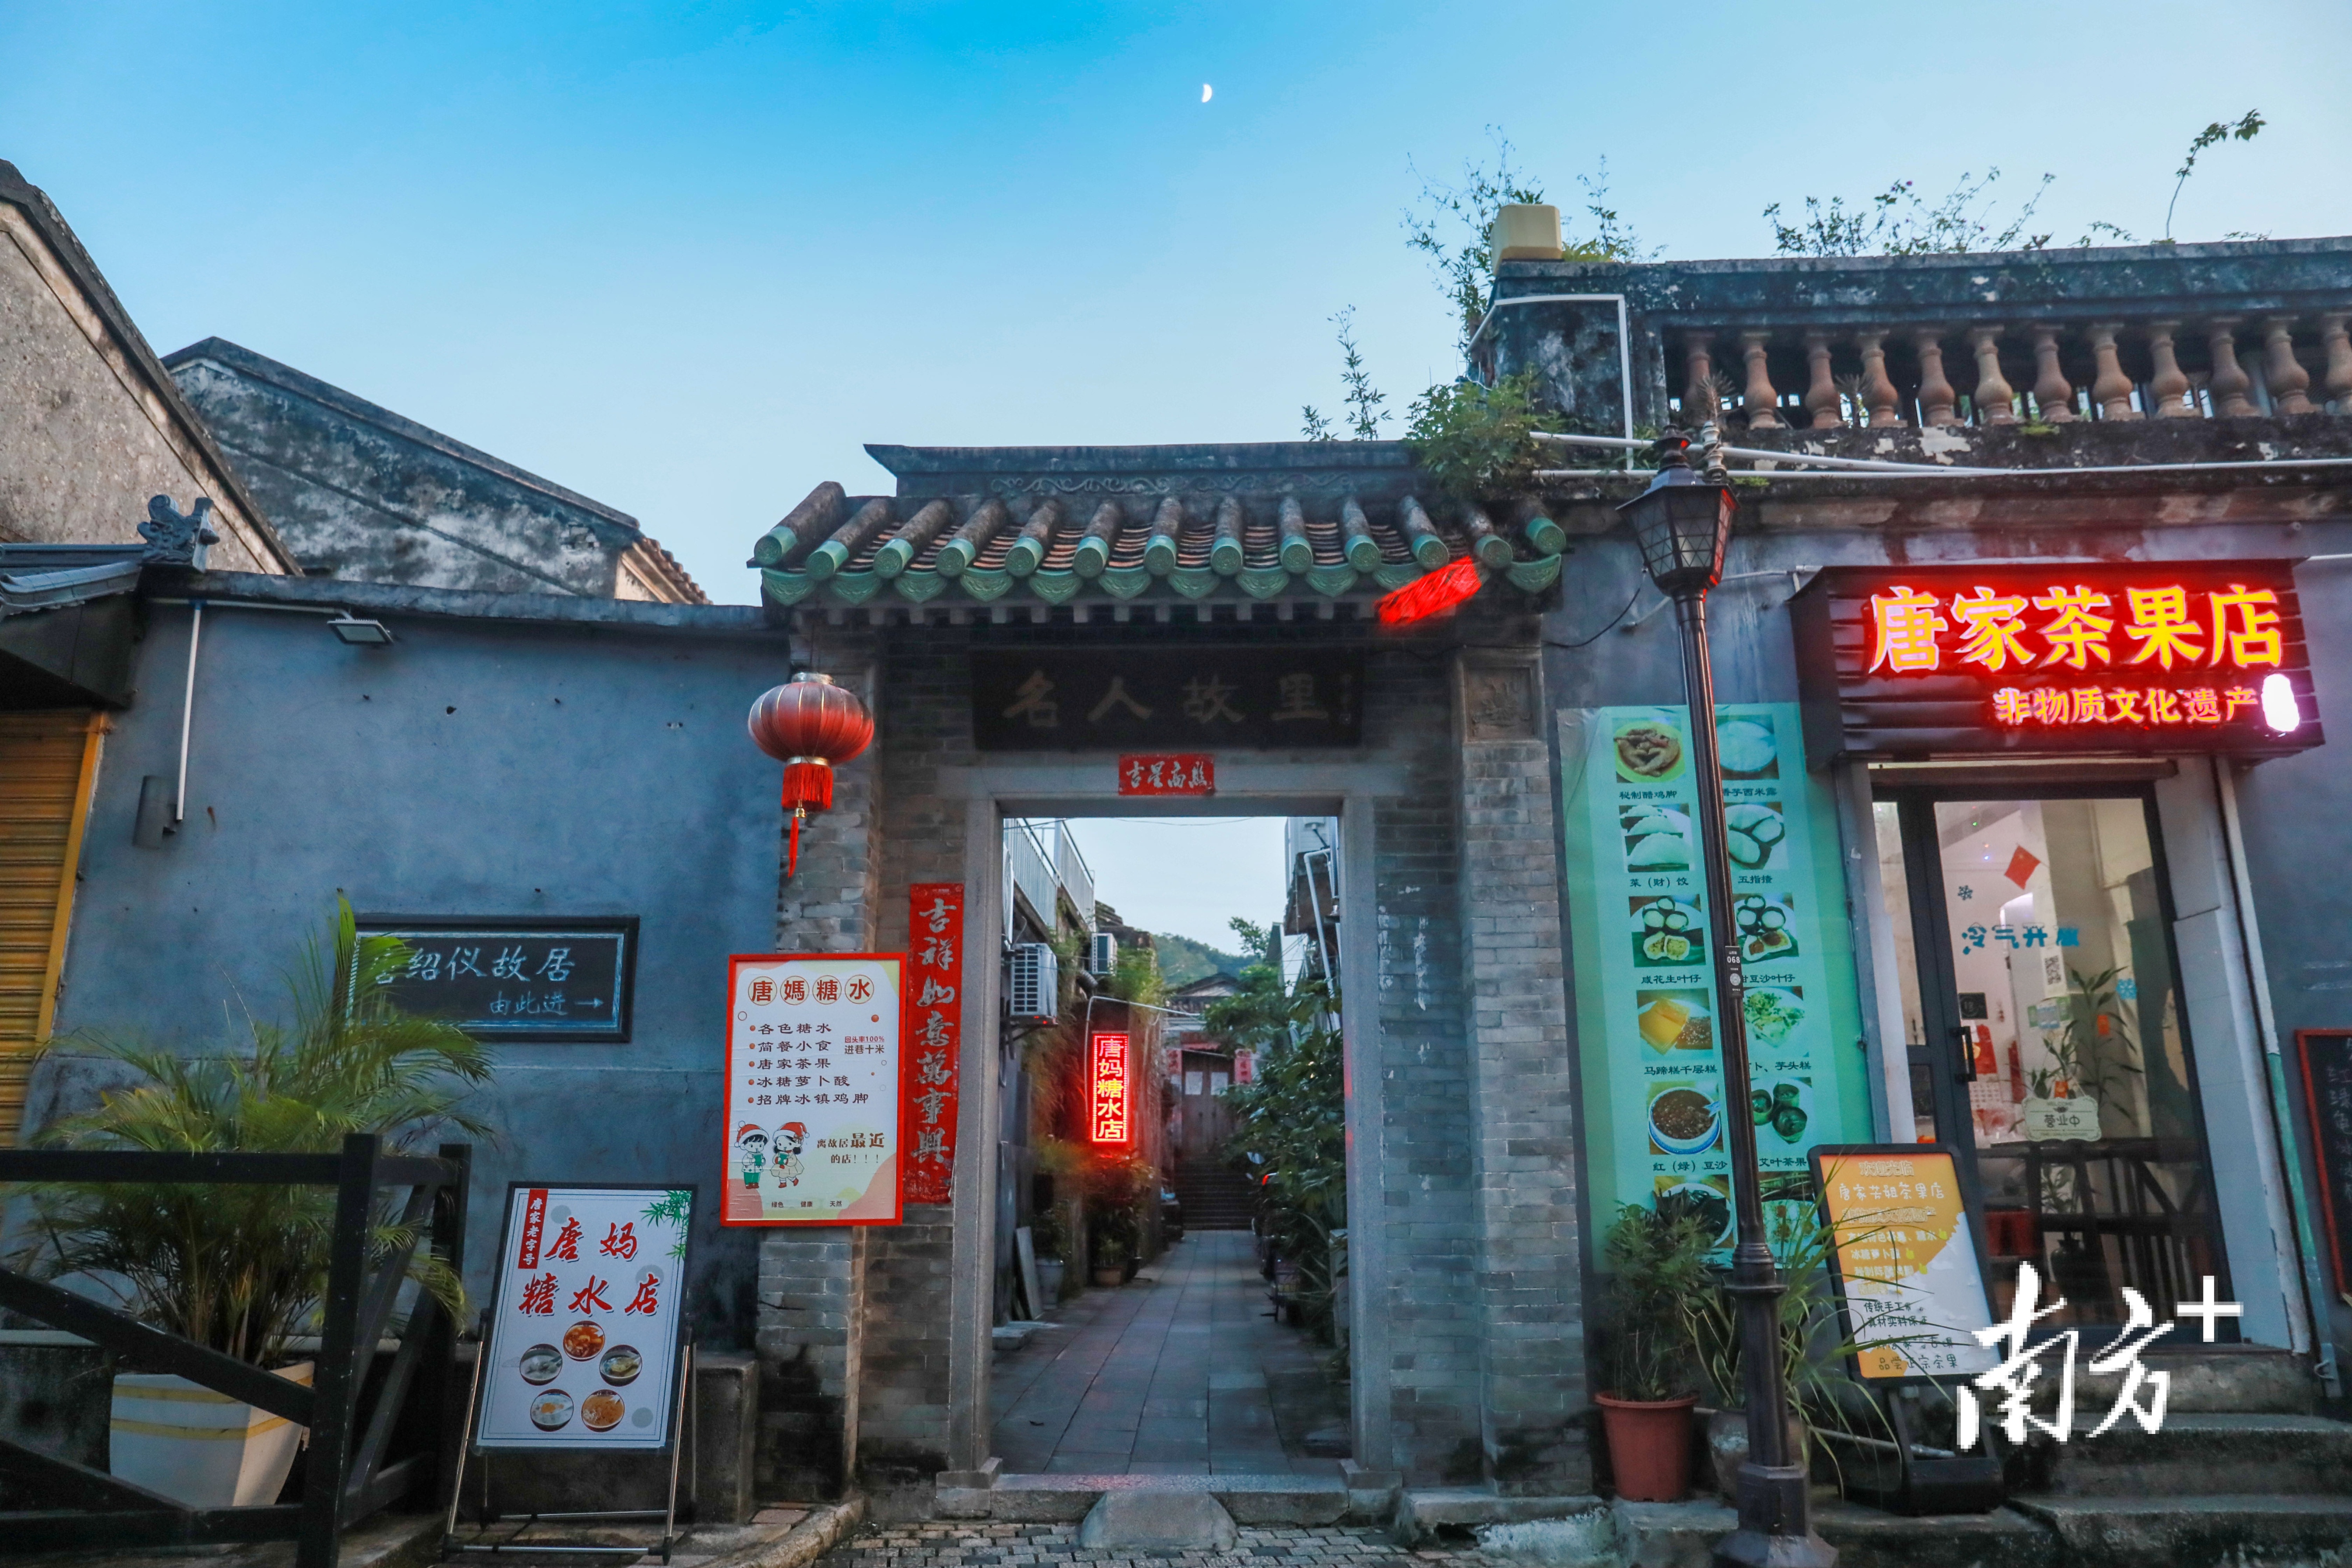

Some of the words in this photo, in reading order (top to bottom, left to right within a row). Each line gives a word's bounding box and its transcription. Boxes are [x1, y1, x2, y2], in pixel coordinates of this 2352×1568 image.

[1869, 584, 2282, 674] 唐家茶果店
[1002, 669, 1328, 728] 名人故里
[1994, 685, 2258, 726] 非物质文化遗产
[1641, 974, 1701, 985] 咸花生叶仔
[751, 979, 871, 1002] 唐媽糖水
[490, 990, 568, 1016] 由此进
[758, 1023, 831, 1034] 各色糖水
[758, 1040, 831, 1052] 简餐小食
[844, 1044, 884, 1054] 进巷十米
[757, 1058, 831, 1069] 唐家茶果
[1749, 1061, 1811, 1072] 卜、芋头糕
[757, 1075, 850, 1087] 冰糖萝卜酸
[1097, 1038, 1124, 1139] 唐妈糖水店
[756, 1093, 869, 1105] 招牌冰镇鸡脚
[2044, 1114, 2080, 1128] 营业中
[817, 1132, 885, 1148] 离故居最近
[1859, 1160, 1914, 1176] 欢迎光临
[523, 1198, 543, 1265] 唐家老字号
[544, 1217, 639, 1262] 唐妈
[518, 1272, 661, 1316] 糖水店
